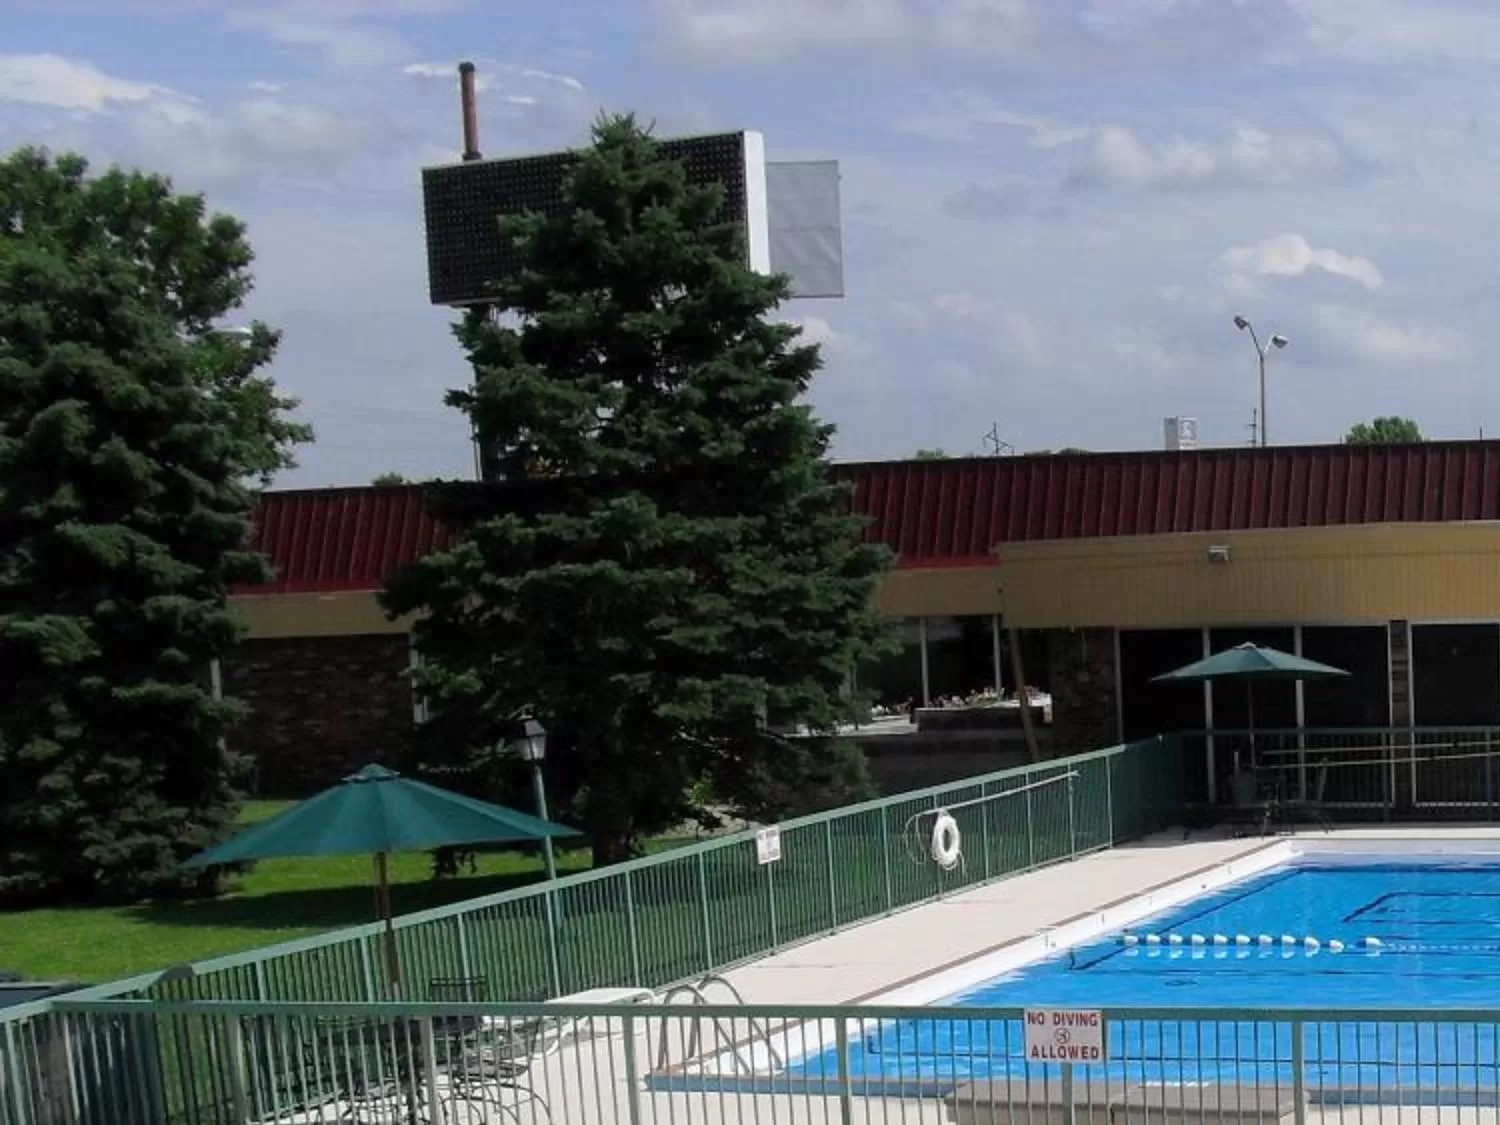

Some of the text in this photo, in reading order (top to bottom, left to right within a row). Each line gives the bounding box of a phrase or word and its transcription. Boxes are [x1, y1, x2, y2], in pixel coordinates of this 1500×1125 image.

[1027, 1012, 1098, 1027] NO DIVING
[1031, 1044, 1099, 1059] ALLOWED
